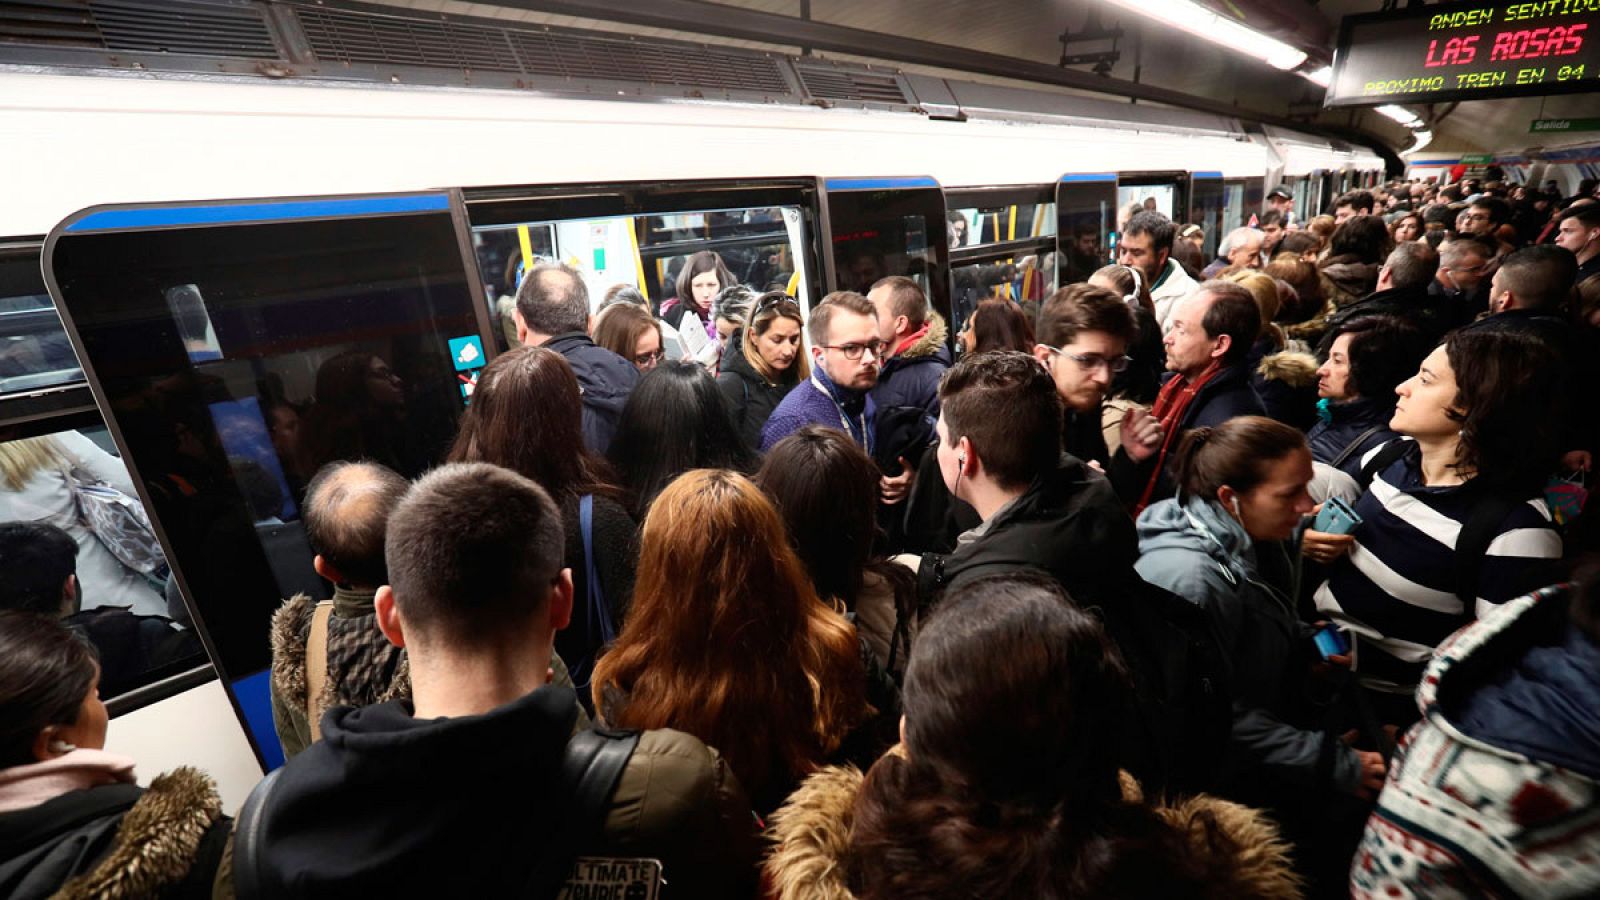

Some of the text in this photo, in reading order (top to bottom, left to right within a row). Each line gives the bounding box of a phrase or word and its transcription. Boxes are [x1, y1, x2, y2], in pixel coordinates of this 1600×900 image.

[1429, 8, 1494, 30] ANDEN
[1424, 23, 1588, 69] LAS ROSAS
[1362, 64, 1586, 97] PROXIMO TREN EN 04
[1535, 120, 1570, 130] Salida
